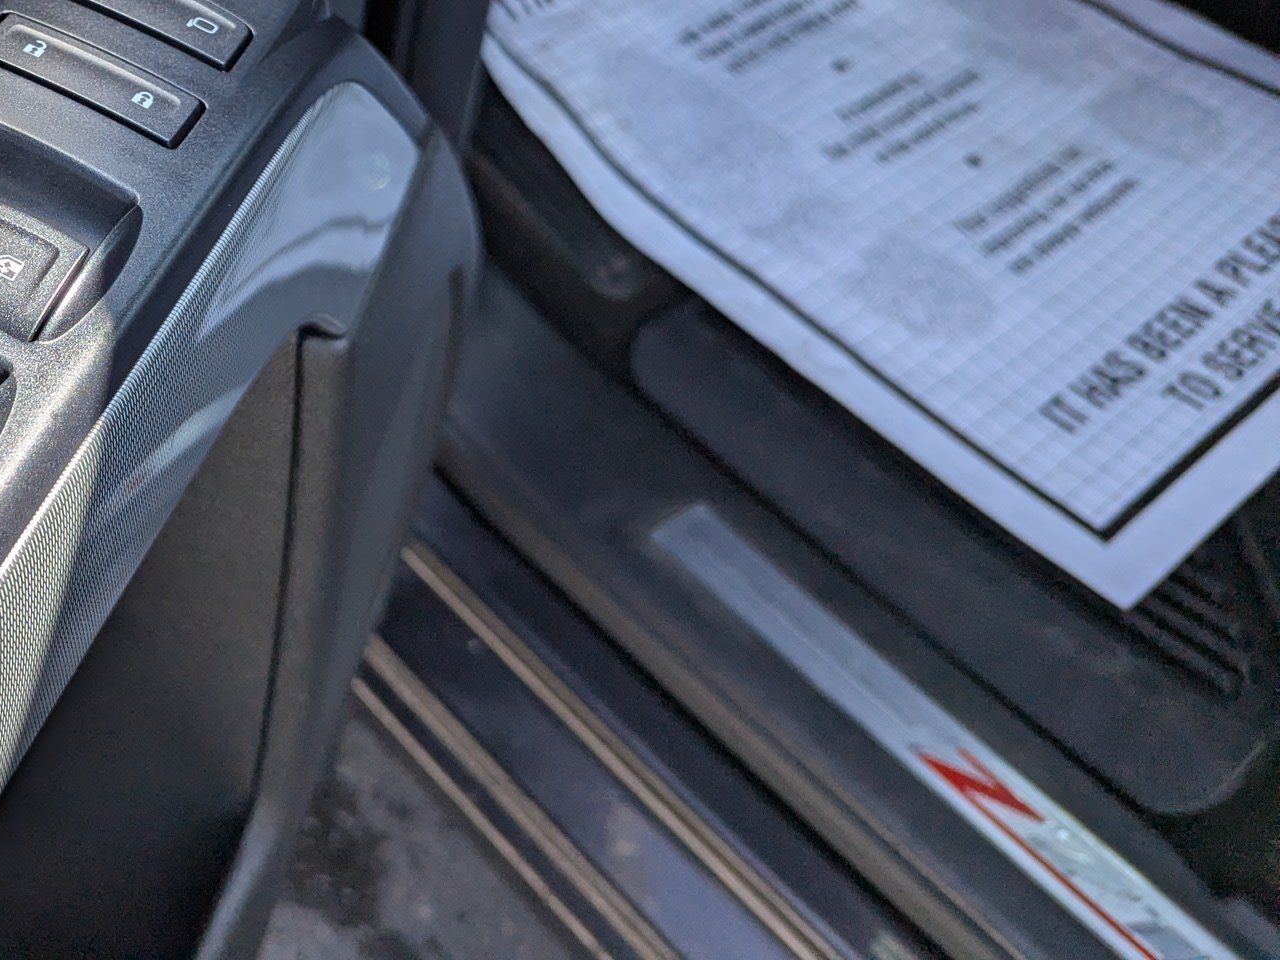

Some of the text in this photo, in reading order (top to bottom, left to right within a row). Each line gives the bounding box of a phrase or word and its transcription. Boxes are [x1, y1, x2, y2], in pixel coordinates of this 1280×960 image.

[1039, 393, 1088, 431] IT
[1069, 351, 1147, 410] HAS
[1126, 295, 1215, 362] BEEN
[1195, 278, 1236, 309] A
[1162, 371, 1223, 411] TO
